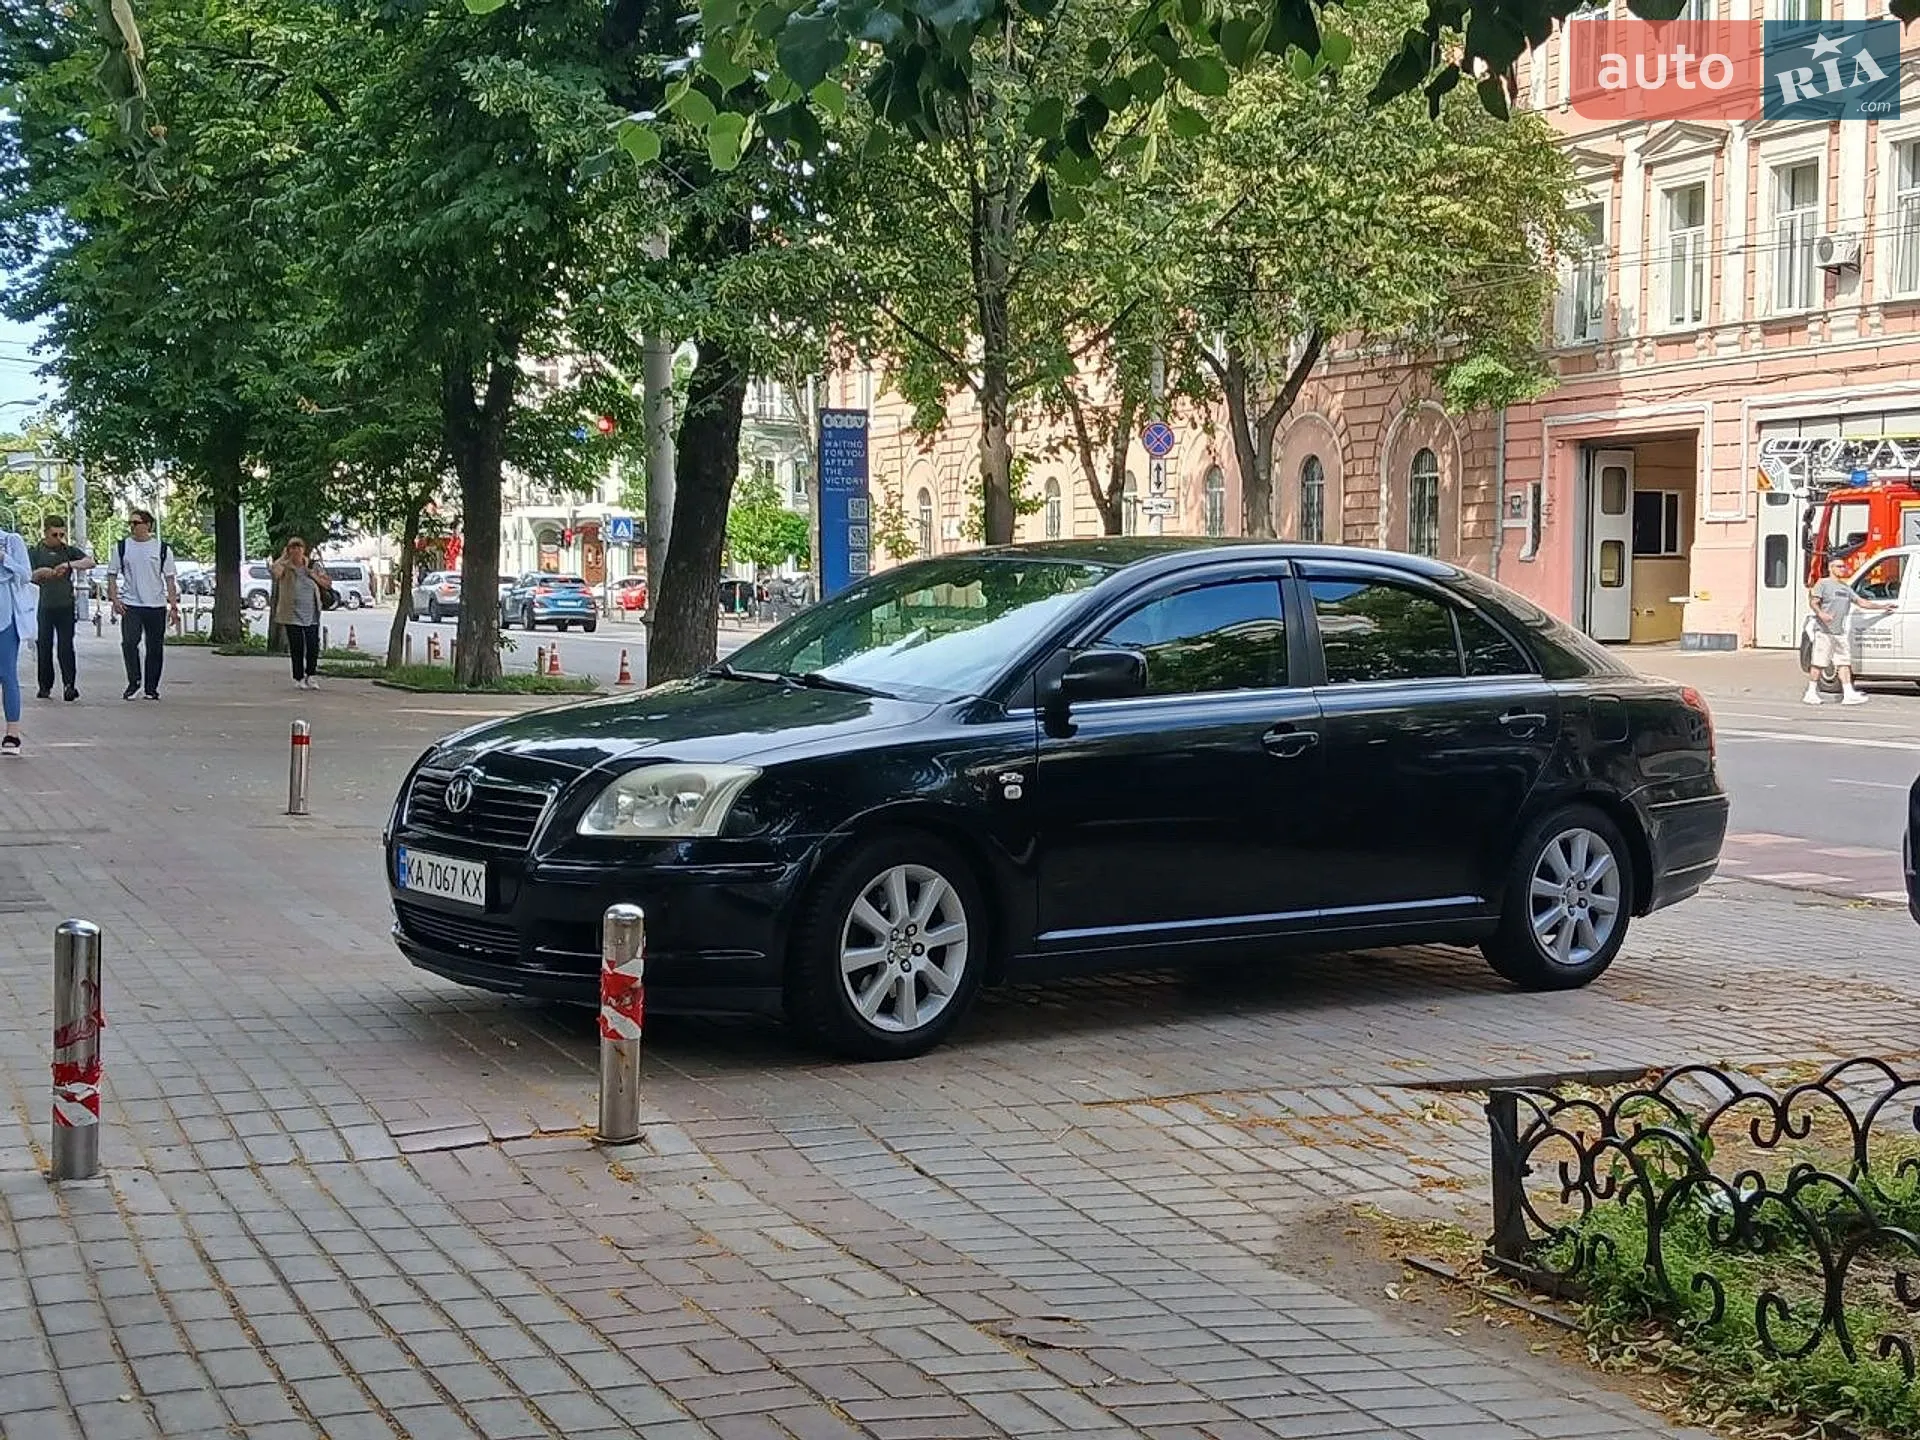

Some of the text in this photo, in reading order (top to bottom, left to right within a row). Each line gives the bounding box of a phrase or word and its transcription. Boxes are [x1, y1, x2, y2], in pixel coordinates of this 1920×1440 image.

[824, 441, 864, 449] WAITING
[846, 450, 866, 458] YOU
[824, 459, 854, 467] AFTER
[825, 468, 843, 476] THE
[406, 857, 483, 898] KA 7067 KX
